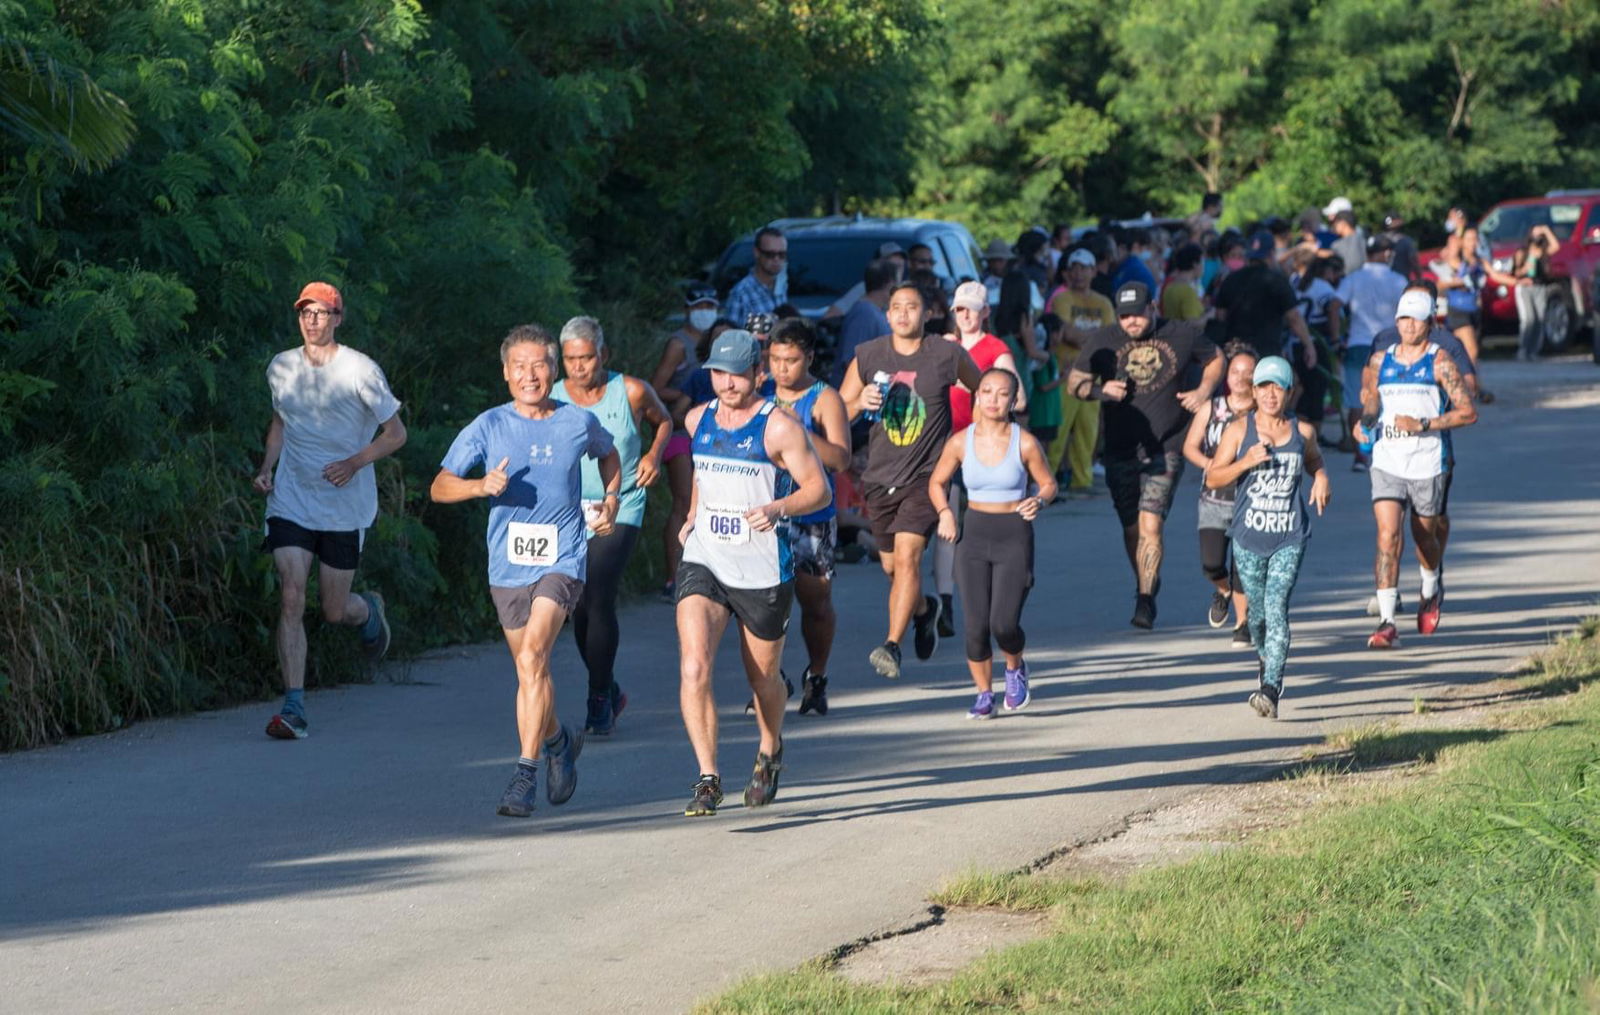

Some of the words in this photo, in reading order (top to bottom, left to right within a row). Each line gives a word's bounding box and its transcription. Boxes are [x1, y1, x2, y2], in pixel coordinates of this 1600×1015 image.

[712, 462, 760, 477] SAIPAN
[1244, 508, 1296, 533] SORRY
[514, 536, 549, 557] 642
